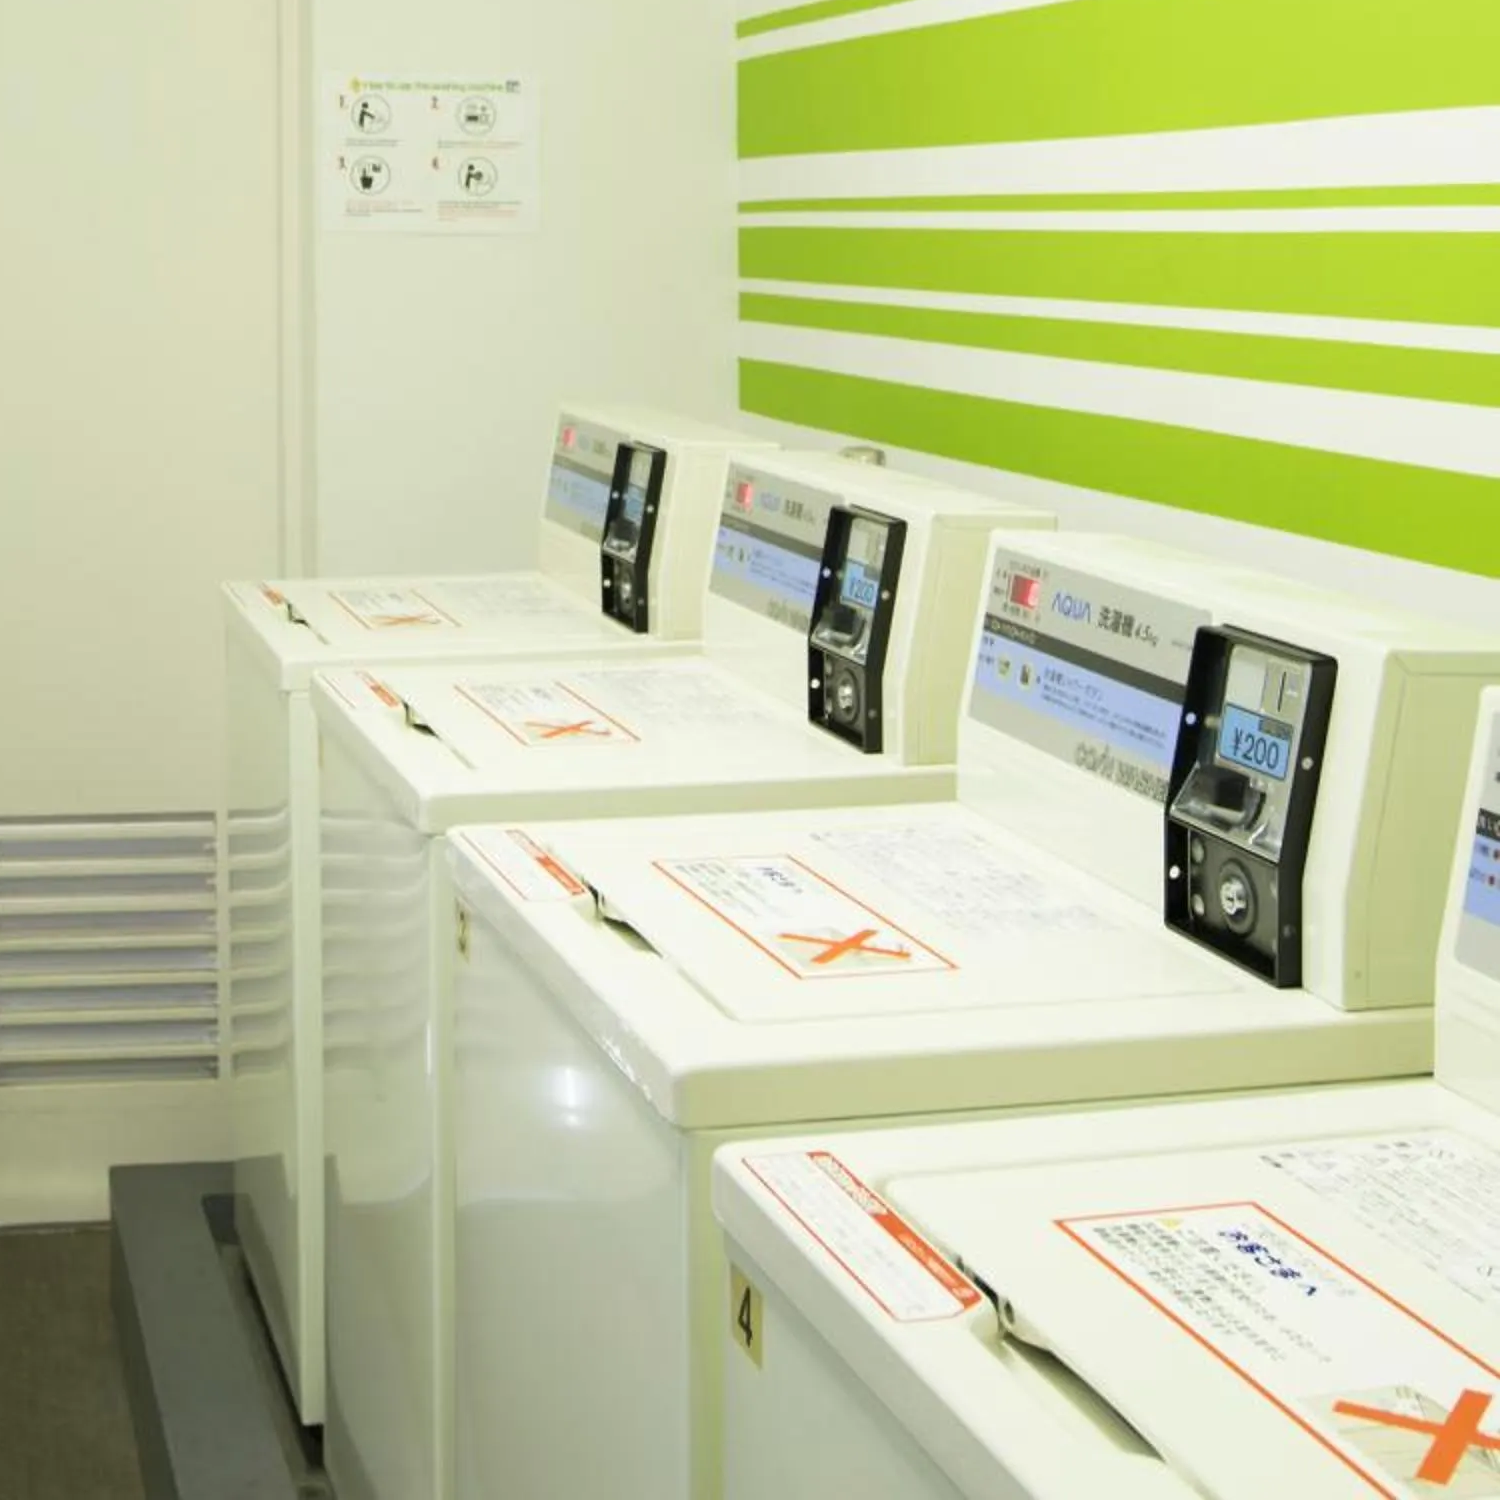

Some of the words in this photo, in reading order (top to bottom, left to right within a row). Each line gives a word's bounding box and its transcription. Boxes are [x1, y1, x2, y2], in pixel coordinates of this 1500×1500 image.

[1051, 591, 1091, 625] AQUA
[1232, 726, 1280, 770] ¥200
[736, 1285, 754, 1349] 4
